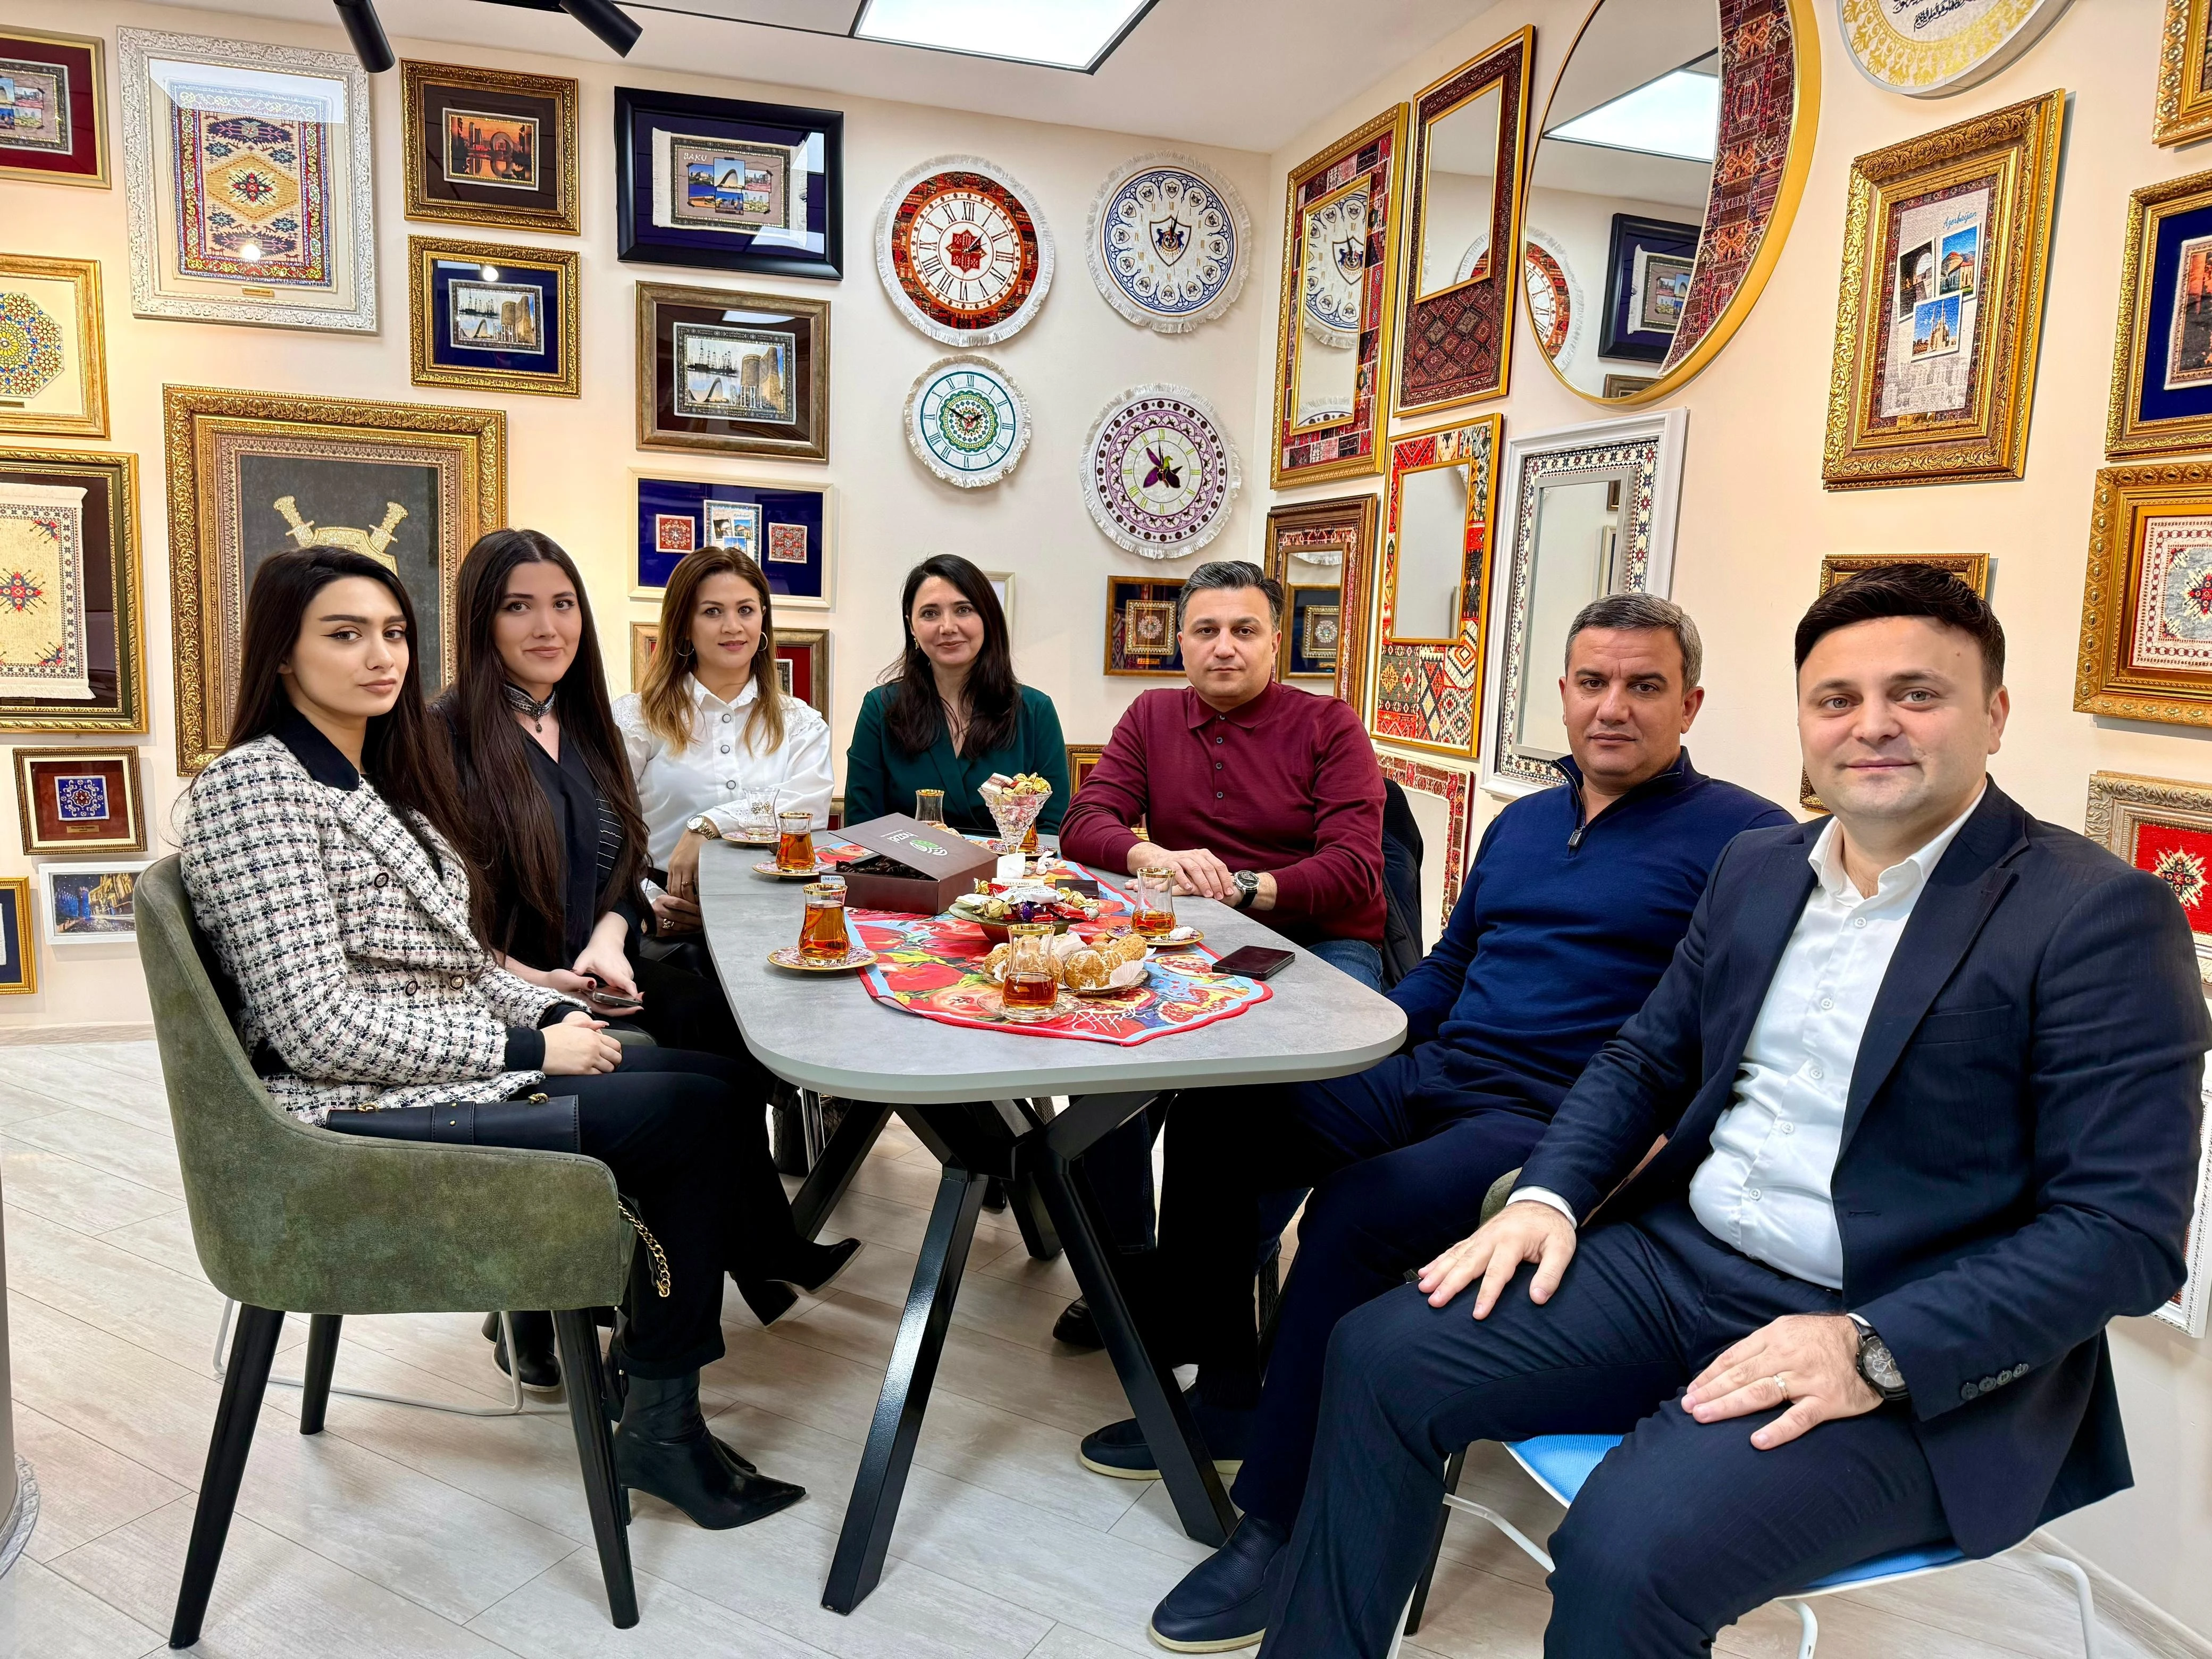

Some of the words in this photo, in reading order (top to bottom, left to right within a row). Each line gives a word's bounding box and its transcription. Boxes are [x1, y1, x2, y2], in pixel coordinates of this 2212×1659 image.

[683, 153, 707, 162] BAKU
[941, 204, 957, 224] XI
[962, 202, 975, 221] XII
[925, 218, 943, 234] X
[982, 212, 993, 227] I
[1942, 212, 1977, 230] Azerbaijan
[991, 230, 1009, 242] II
[919, 240, 937, 251] IX
[995, 250, 1014, 263] III
[921, 255, 943, 278] VIII
[989, 266, 1007, 285] IV
[937, 272, 954, 295] VII
[978, 279, 989, 298] V
[959, 281, 968, 300] VI
[946, 378, 955, 390] XI
[989, 386, 995, 395] I
[932, 390, 943, 399] X
[928, 433, 941, 446] VIII
[941, 446, 951, 459] VII
[995, 442, 1006, 453] IV
[963, 456, 969, 467] VI
[986, 453, 993, 463] V
[887, 832, 919, 843] hazel
